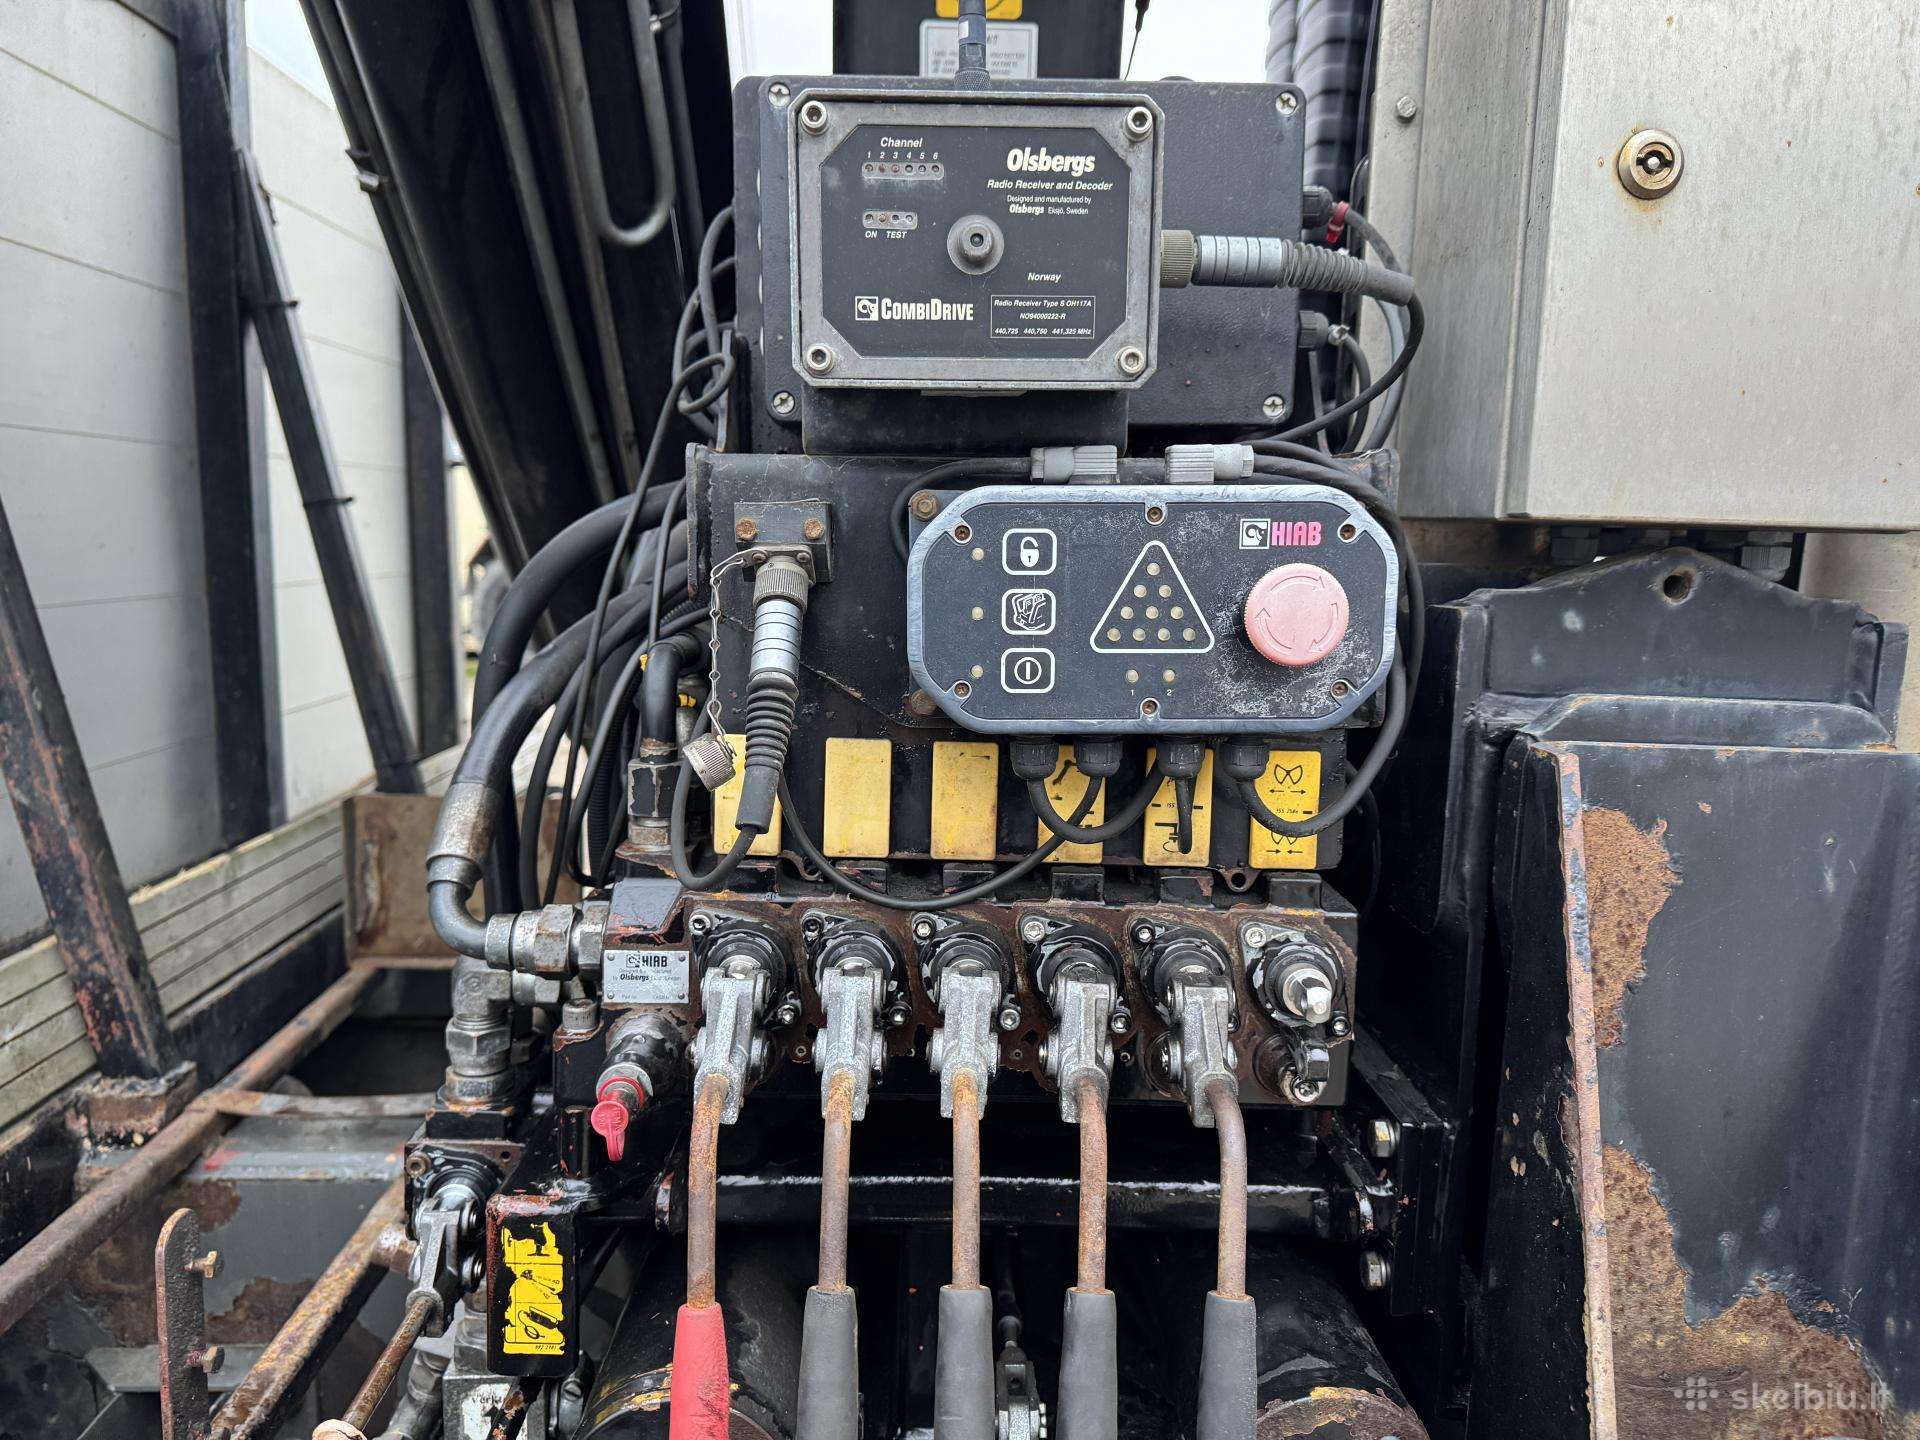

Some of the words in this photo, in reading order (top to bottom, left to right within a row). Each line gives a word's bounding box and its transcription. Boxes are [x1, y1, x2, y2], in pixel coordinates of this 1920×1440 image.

[880, 137, 923, 148] Channel
[920, 152, 926, 160] 5
[933, 152, 939, 160] 6
[1007, 147, 1096, 177] Olsbergs
[987, 179, 1013, 189] Radio
[1015, 180, 1054, 190] Receiver
[1056, 181, 1073, 190] and
[1075, 181, 1114, 191] Decoder
[1007, 195, 1033, 204] Designed
[1084, 197, 1091, 205] by
[1009, 204, 1045, 216] Olsbergs
[1066, 207, 1089, 215] Sweden
[865, 230, 878, 239] ON
[886, 231, 907, 239] TEST
[1027, 272, 1062, 284] Norway
[994, 299, 1012, 307] Radio
[1043, 300, 1058, 308] Type
[1271, 521, 1322, 546] HIAB
[1130, 689, 1135, 697] 1
[1166, 688, 1173, 697] 2
[642, 956, 668, 968] HIAB
[620, 973, 649, 983] Olsbergs
